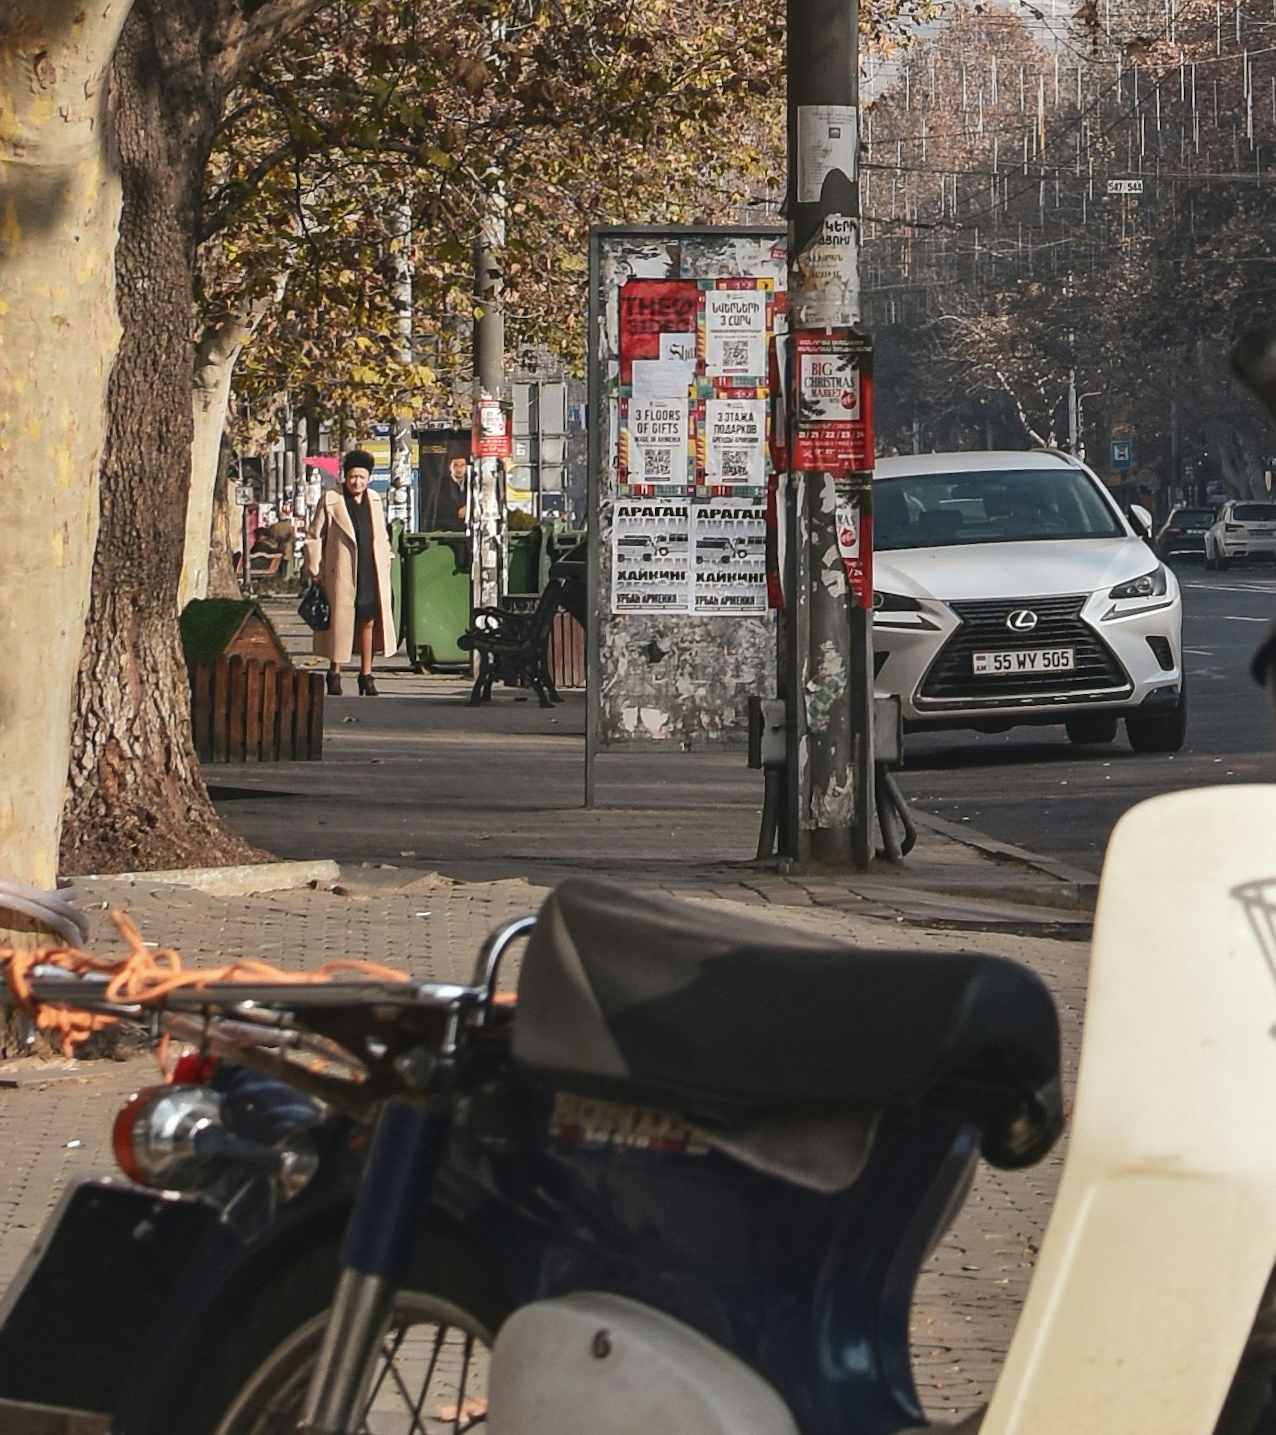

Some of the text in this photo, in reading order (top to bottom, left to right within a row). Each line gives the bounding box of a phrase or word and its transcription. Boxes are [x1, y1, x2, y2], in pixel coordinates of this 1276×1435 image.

[720, 315, 726, 326] 3
[811, 362, 833, 375] BIG
[804, 376, 855, 388] CHRISTMAS
[635, 409, 681, 421] 3 FLOORS
[725, 412, 754, 422] ЭТАЖА
[637, 423, 679, 434] OF GIFTS
[713, 424, 758, 435] ПОДАРКОВ
[618, 507, 688, 518] АРАГАЦ
[696, 509, 766, 519] АРАГАЦ
[617, 569, 687, 580] ХАЙКИНГ
[696, 570, 766, 583] ХАЙКИНГ
[642, 593, 677, 603] АРМЕНИЯ
[994, 651, 1069, 670] 55 WY 505
